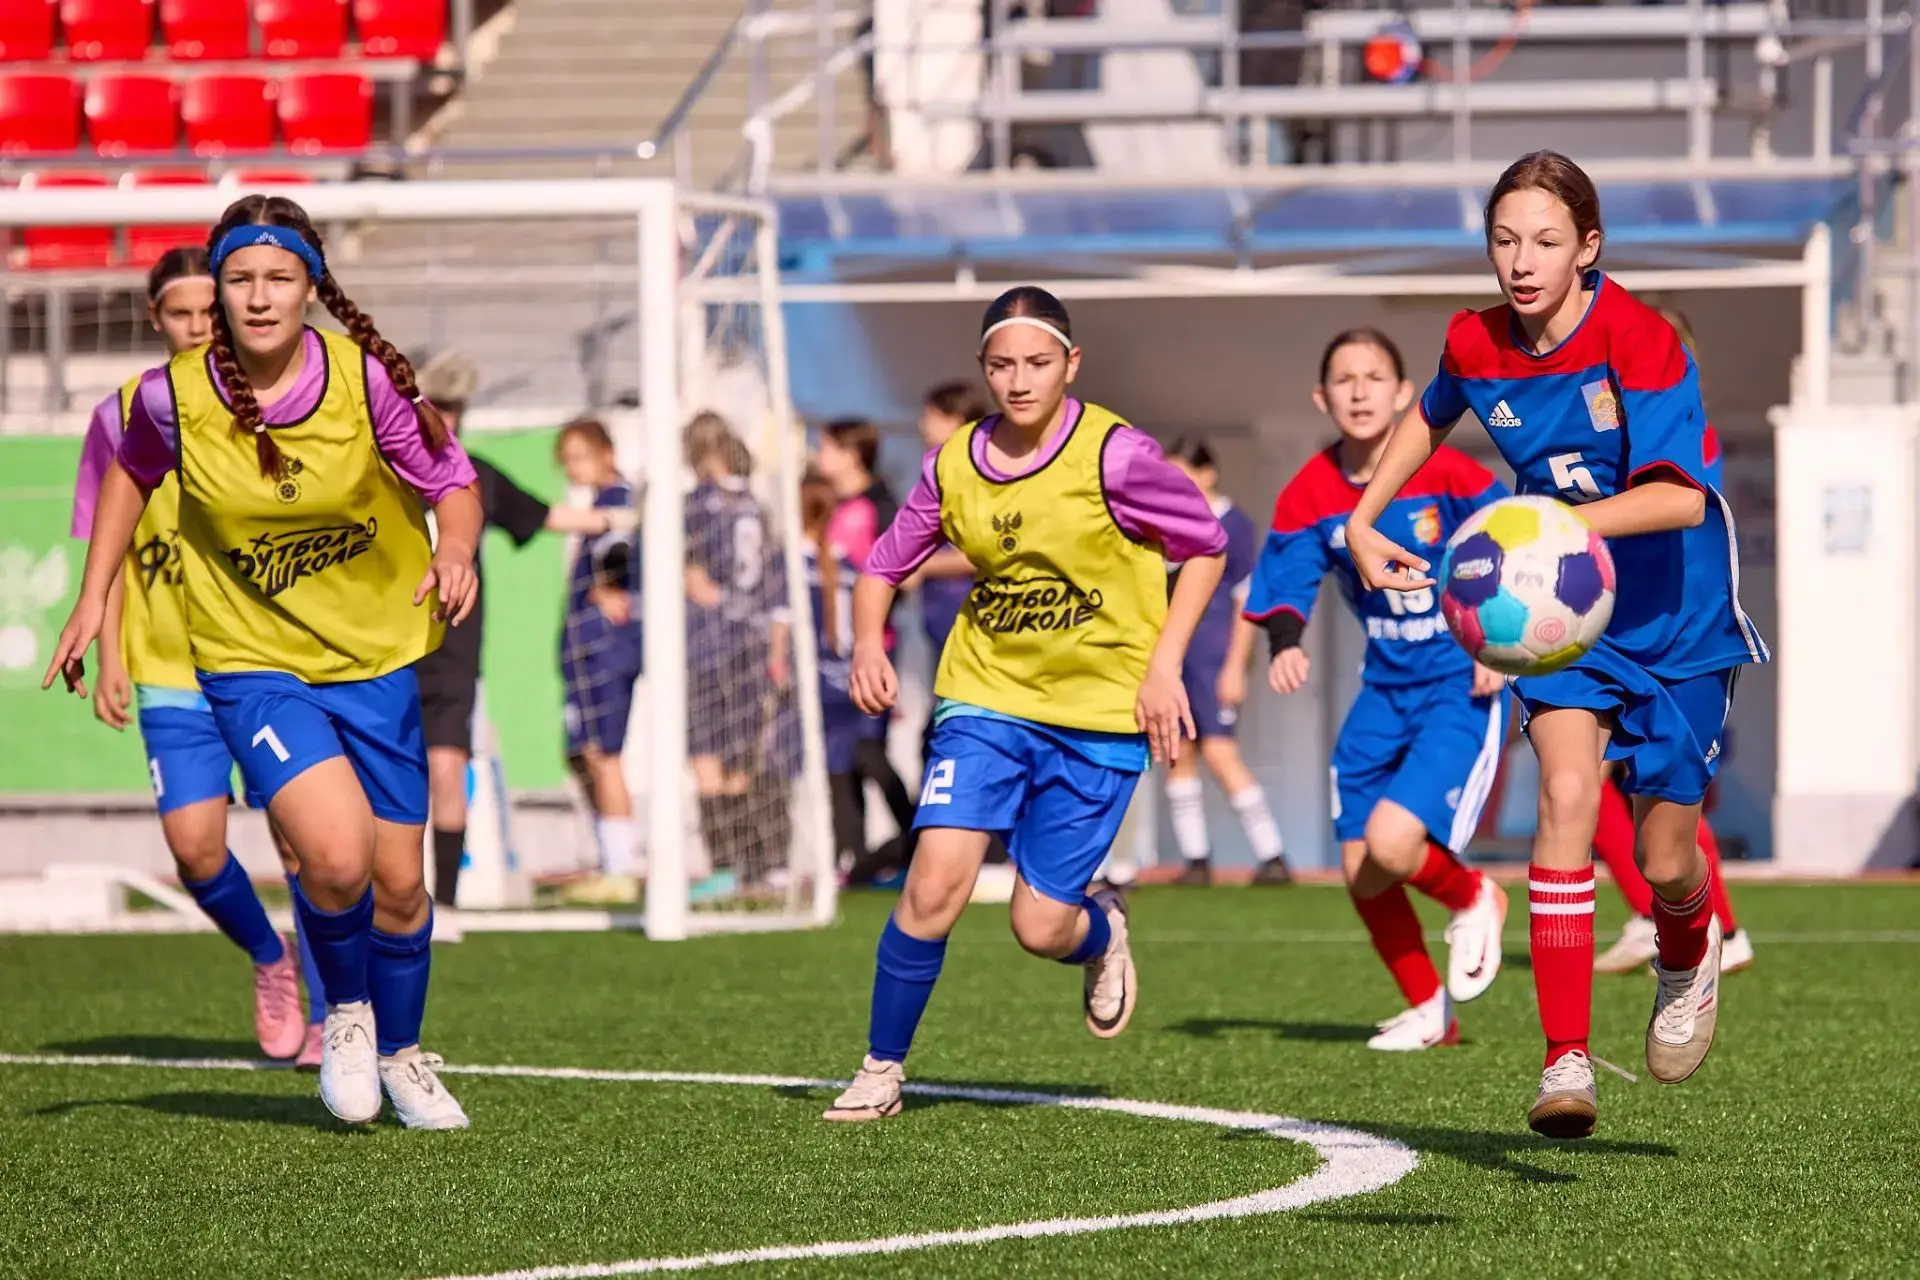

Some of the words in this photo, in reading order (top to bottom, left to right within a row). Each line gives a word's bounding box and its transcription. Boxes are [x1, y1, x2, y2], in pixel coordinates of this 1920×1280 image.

[1488, 416, 1522, 428] adidas
[1548, 451, 1603, 506] 5
[265, 540, 373, 598] ШКОЛЕ
[993, 605, 1095, 634] ШКОЛЕ
[920, 758, 956, 807] 12
